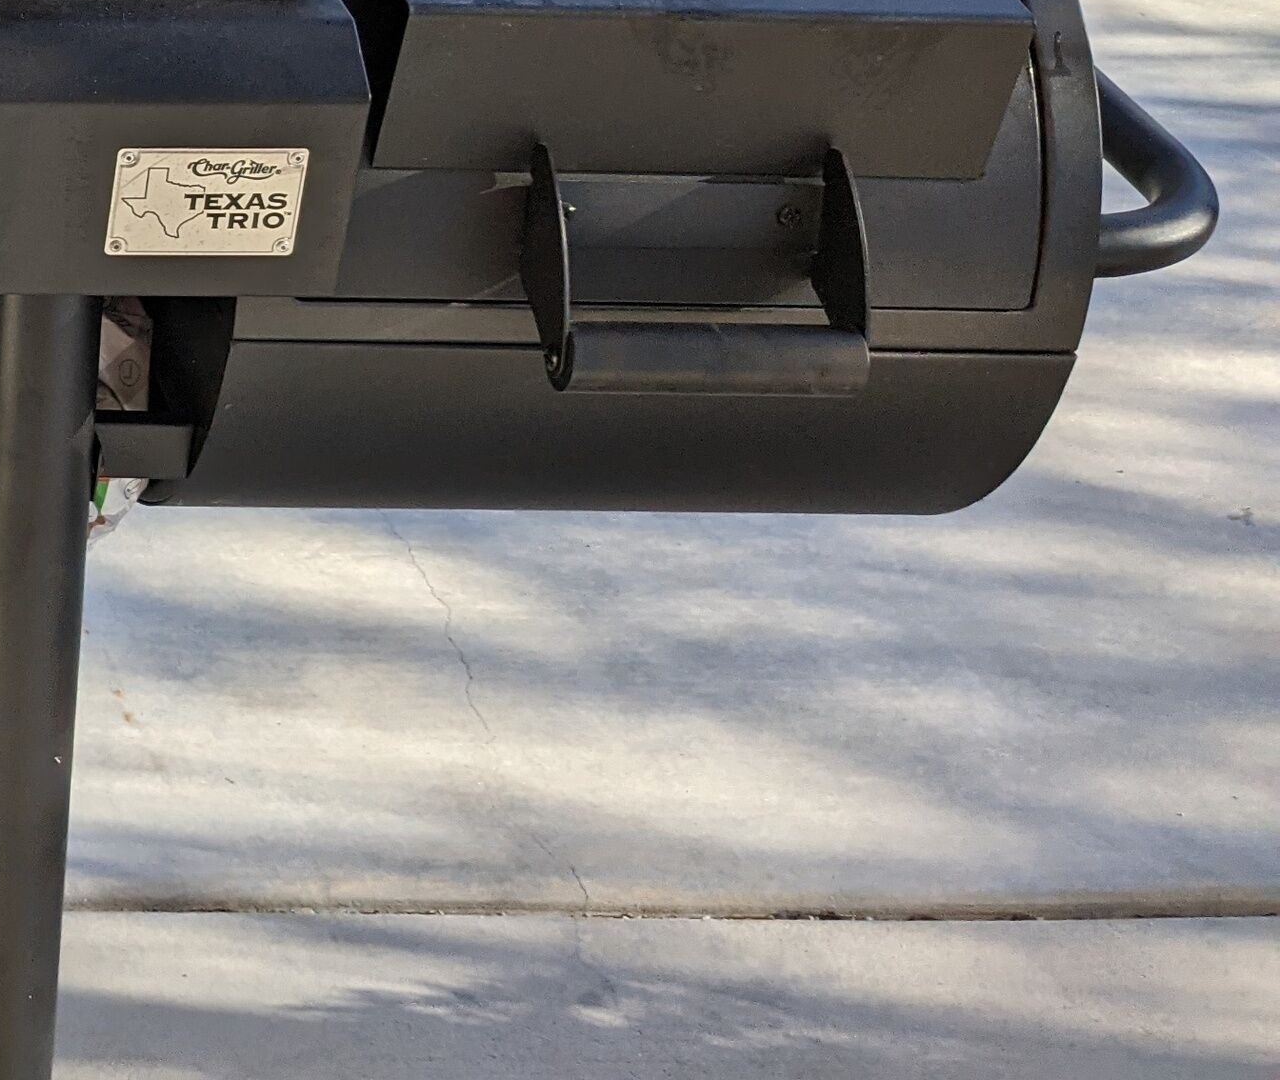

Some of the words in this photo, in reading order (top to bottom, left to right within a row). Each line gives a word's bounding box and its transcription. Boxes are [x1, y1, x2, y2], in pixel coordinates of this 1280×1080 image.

[187, 158, 277, 184] Char-Griller
[184, 193, 288, 210] TEXAS
[206, 212, 285, 229] TRIO
